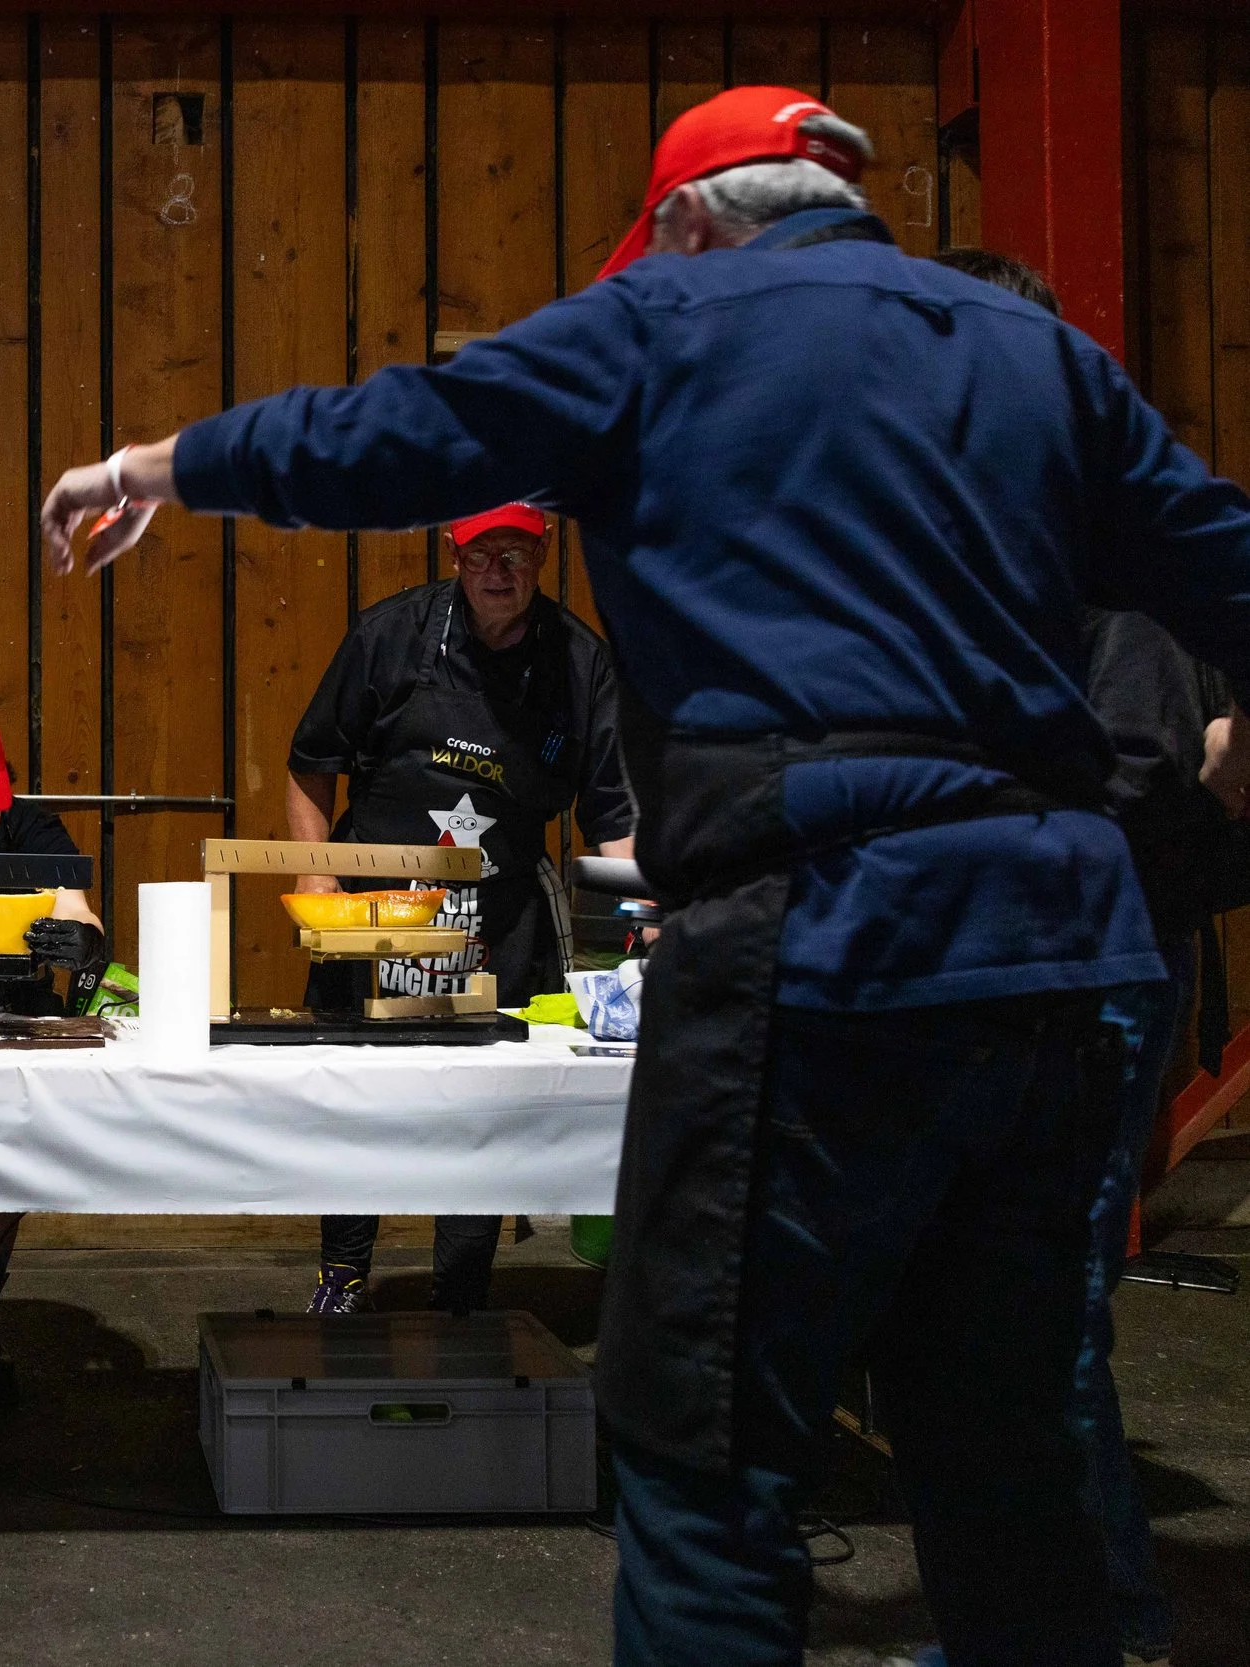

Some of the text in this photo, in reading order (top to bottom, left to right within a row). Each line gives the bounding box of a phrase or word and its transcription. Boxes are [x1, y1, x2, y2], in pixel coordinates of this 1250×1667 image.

[160, 173, 197, 225] 8
[430, 745, 504, 784] VALDOR
[446, 737, 491, 756] cremo
[379, 960, 490, 997] RACLETT
